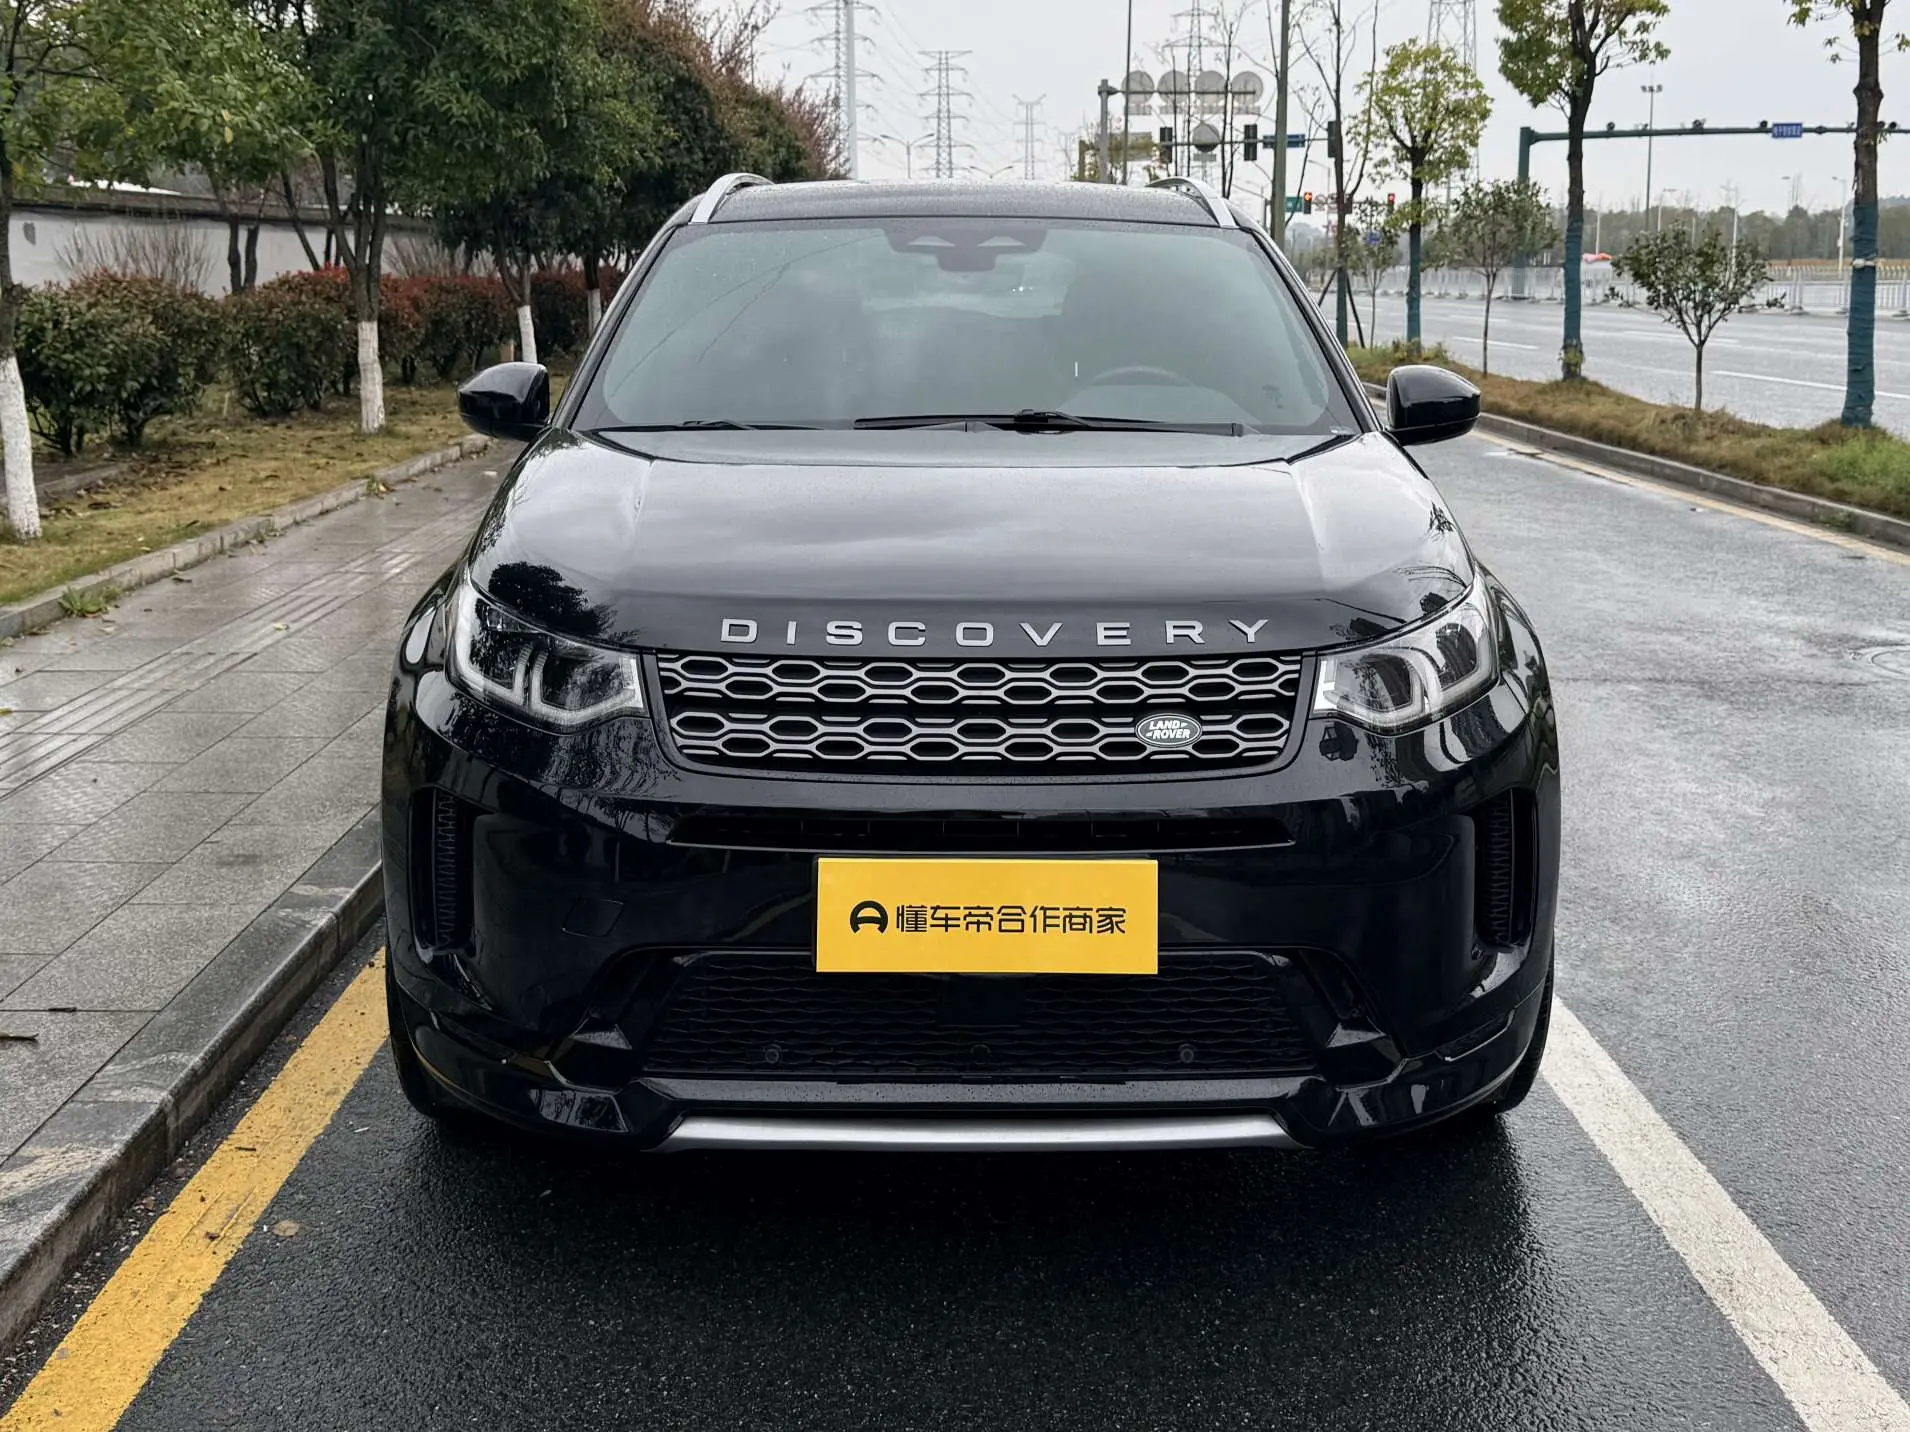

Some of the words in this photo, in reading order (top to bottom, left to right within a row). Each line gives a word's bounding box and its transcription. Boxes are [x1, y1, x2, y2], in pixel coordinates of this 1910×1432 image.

[720, 618, 1269, 647] DISCOVERY
[1149, 719, 1181, 731] LAND
[1152, 728, 1191, 740] ROVER
[896, 904, 1127, 934] 懂车帝合作商家
